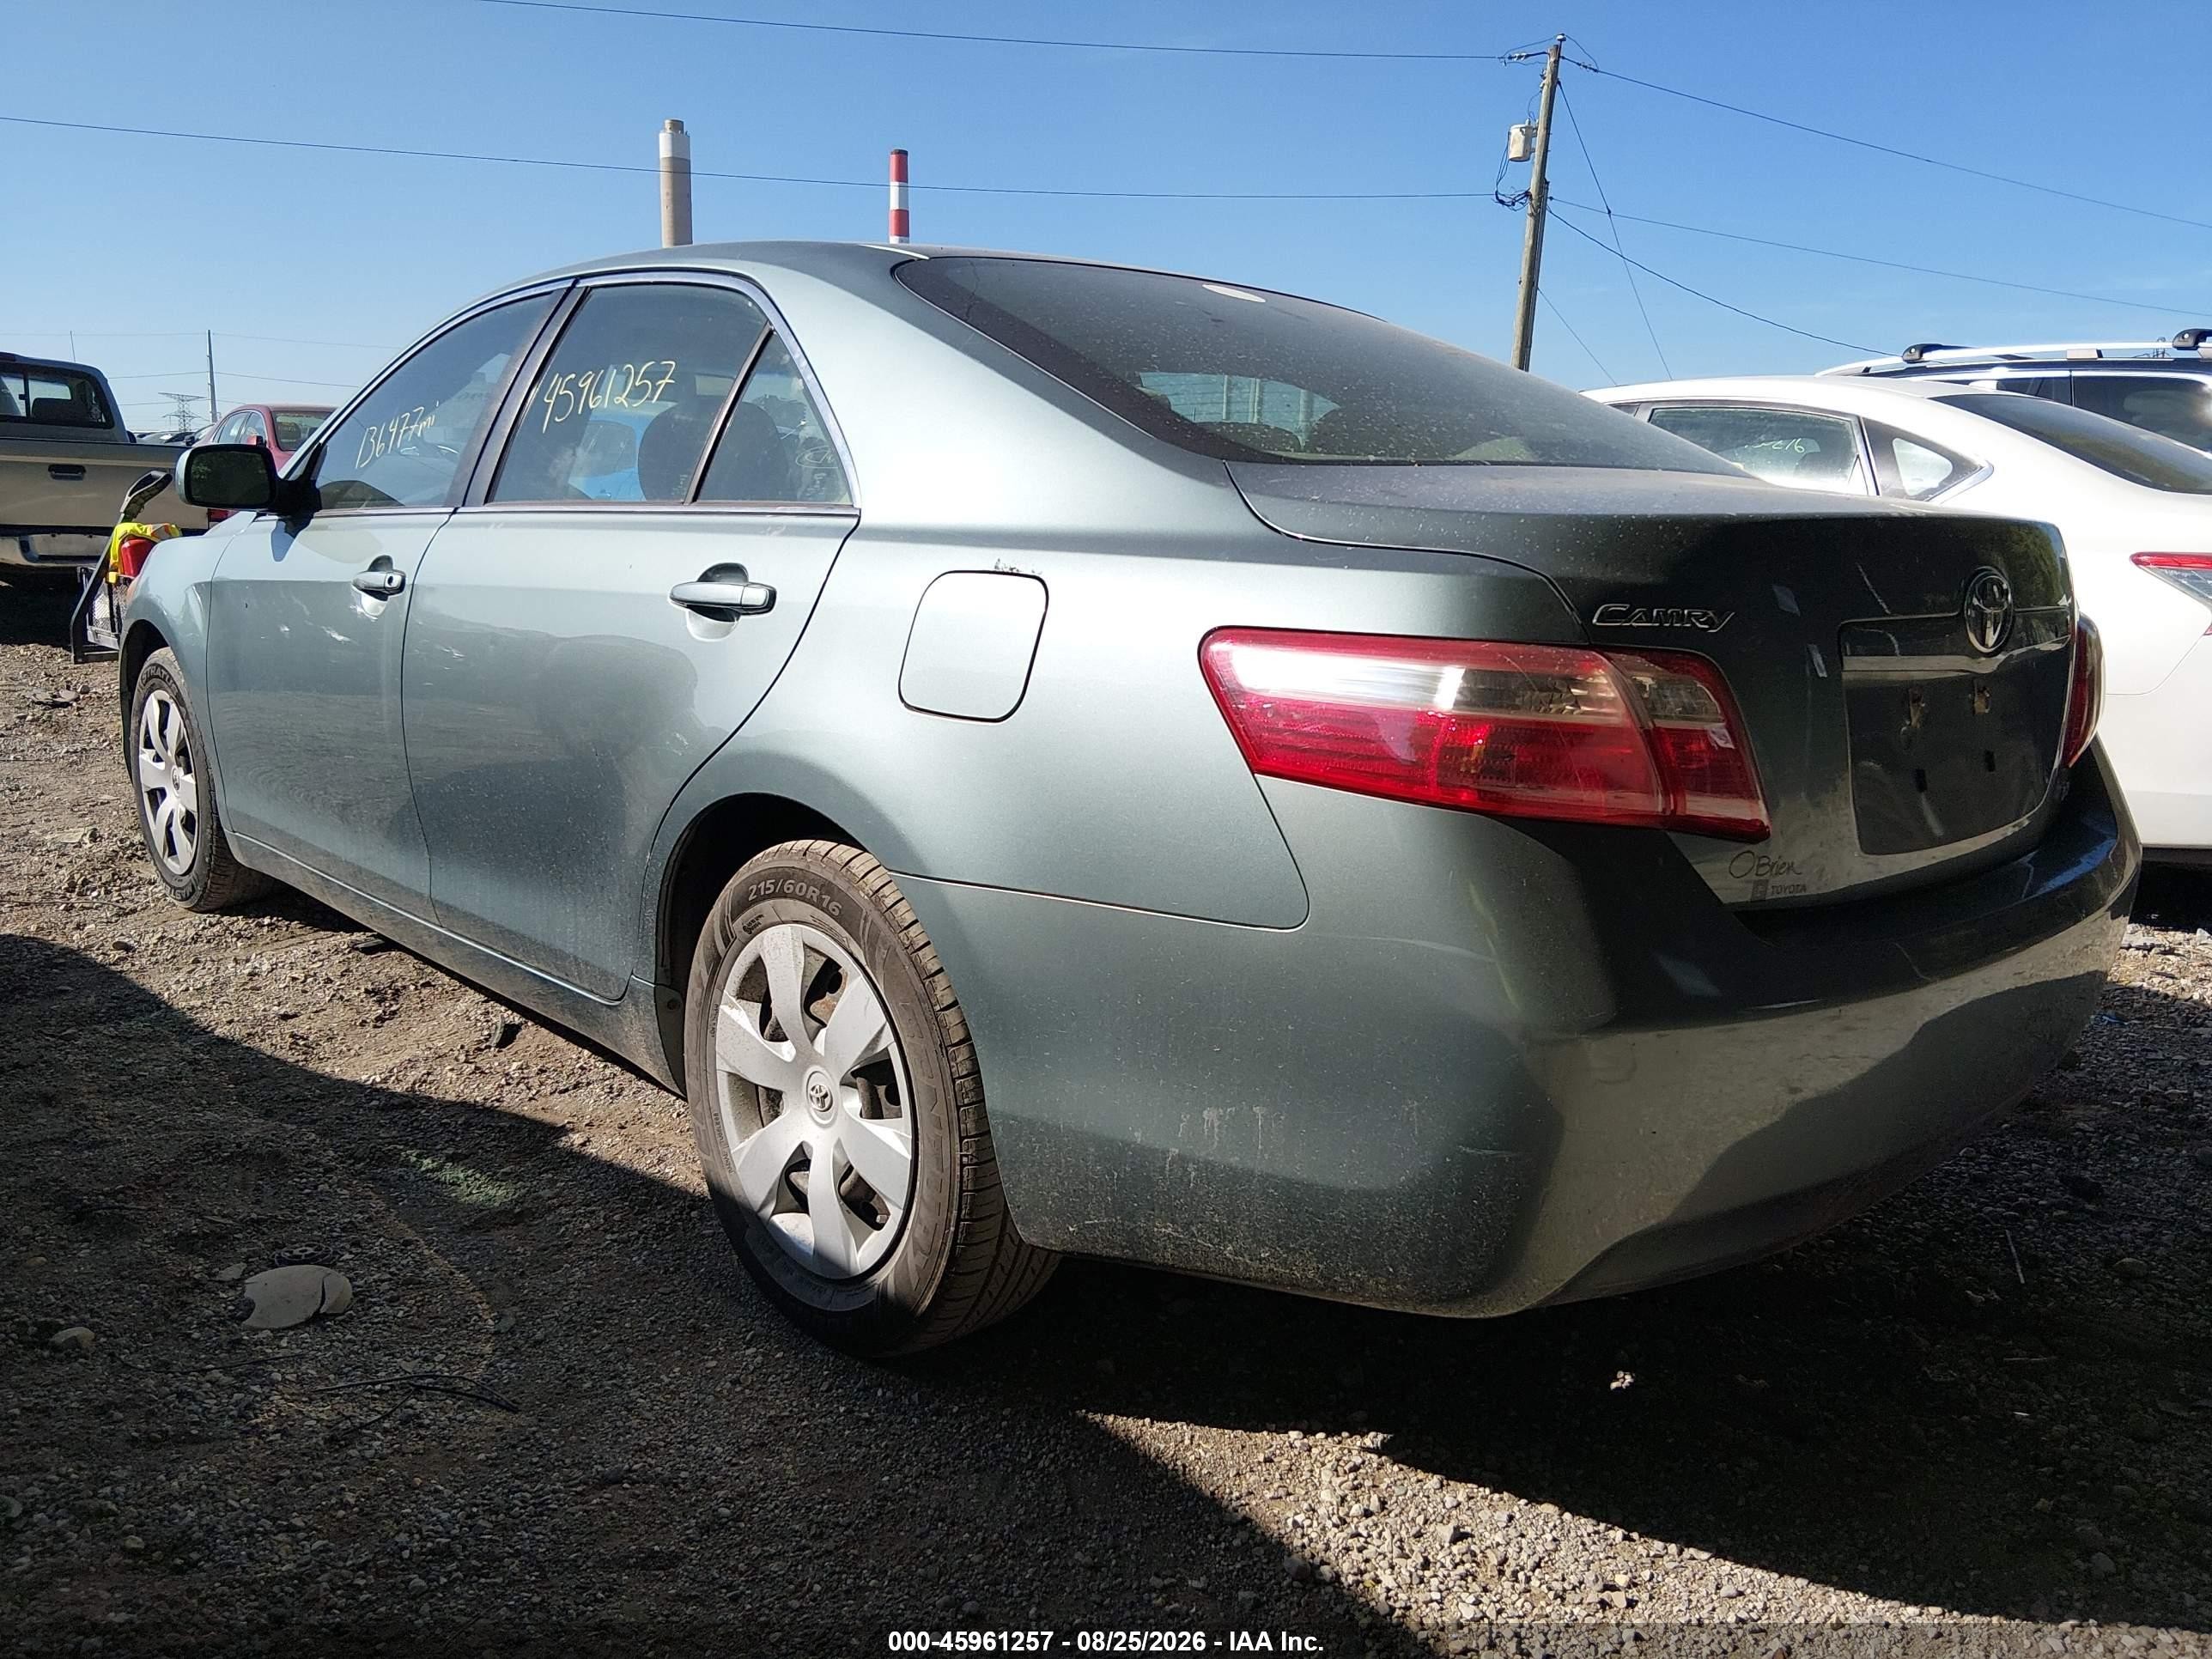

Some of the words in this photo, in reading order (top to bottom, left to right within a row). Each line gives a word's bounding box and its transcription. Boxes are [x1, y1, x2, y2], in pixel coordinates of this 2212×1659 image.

[542, 361, 676, 434] 45961257
[1593, 604, 1735, 633] CAMRY
[748, 878, 842, 916] 215/60R16
[1771, 884, 1808, 895] TOYOTA
